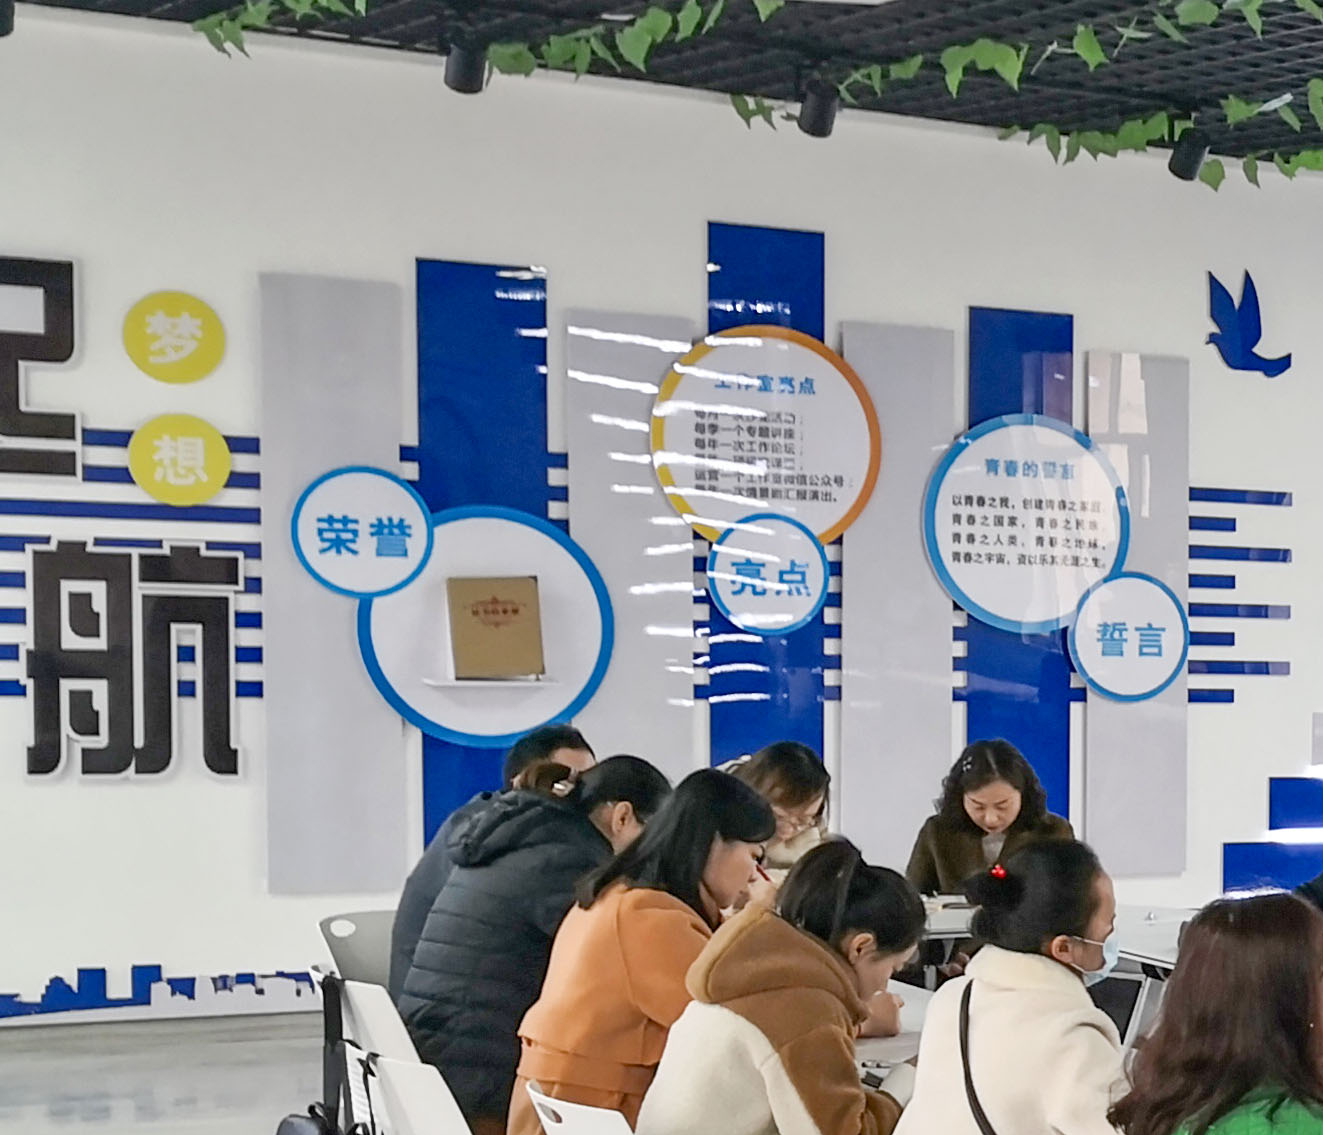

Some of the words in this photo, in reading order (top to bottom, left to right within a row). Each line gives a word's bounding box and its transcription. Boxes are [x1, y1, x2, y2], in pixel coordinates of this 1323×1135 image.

[145, 310, 203, 364] 梦
[151, 434, 207, 487] 想
[984, 458, 1075, 479] 青春的誓言
[316, 514, 412, 557] 荣誉
[729, 557, 811, 597] 亮点
[26, 541, 240, 775] 航
[1096, 621, 1167, 657] 誓言
